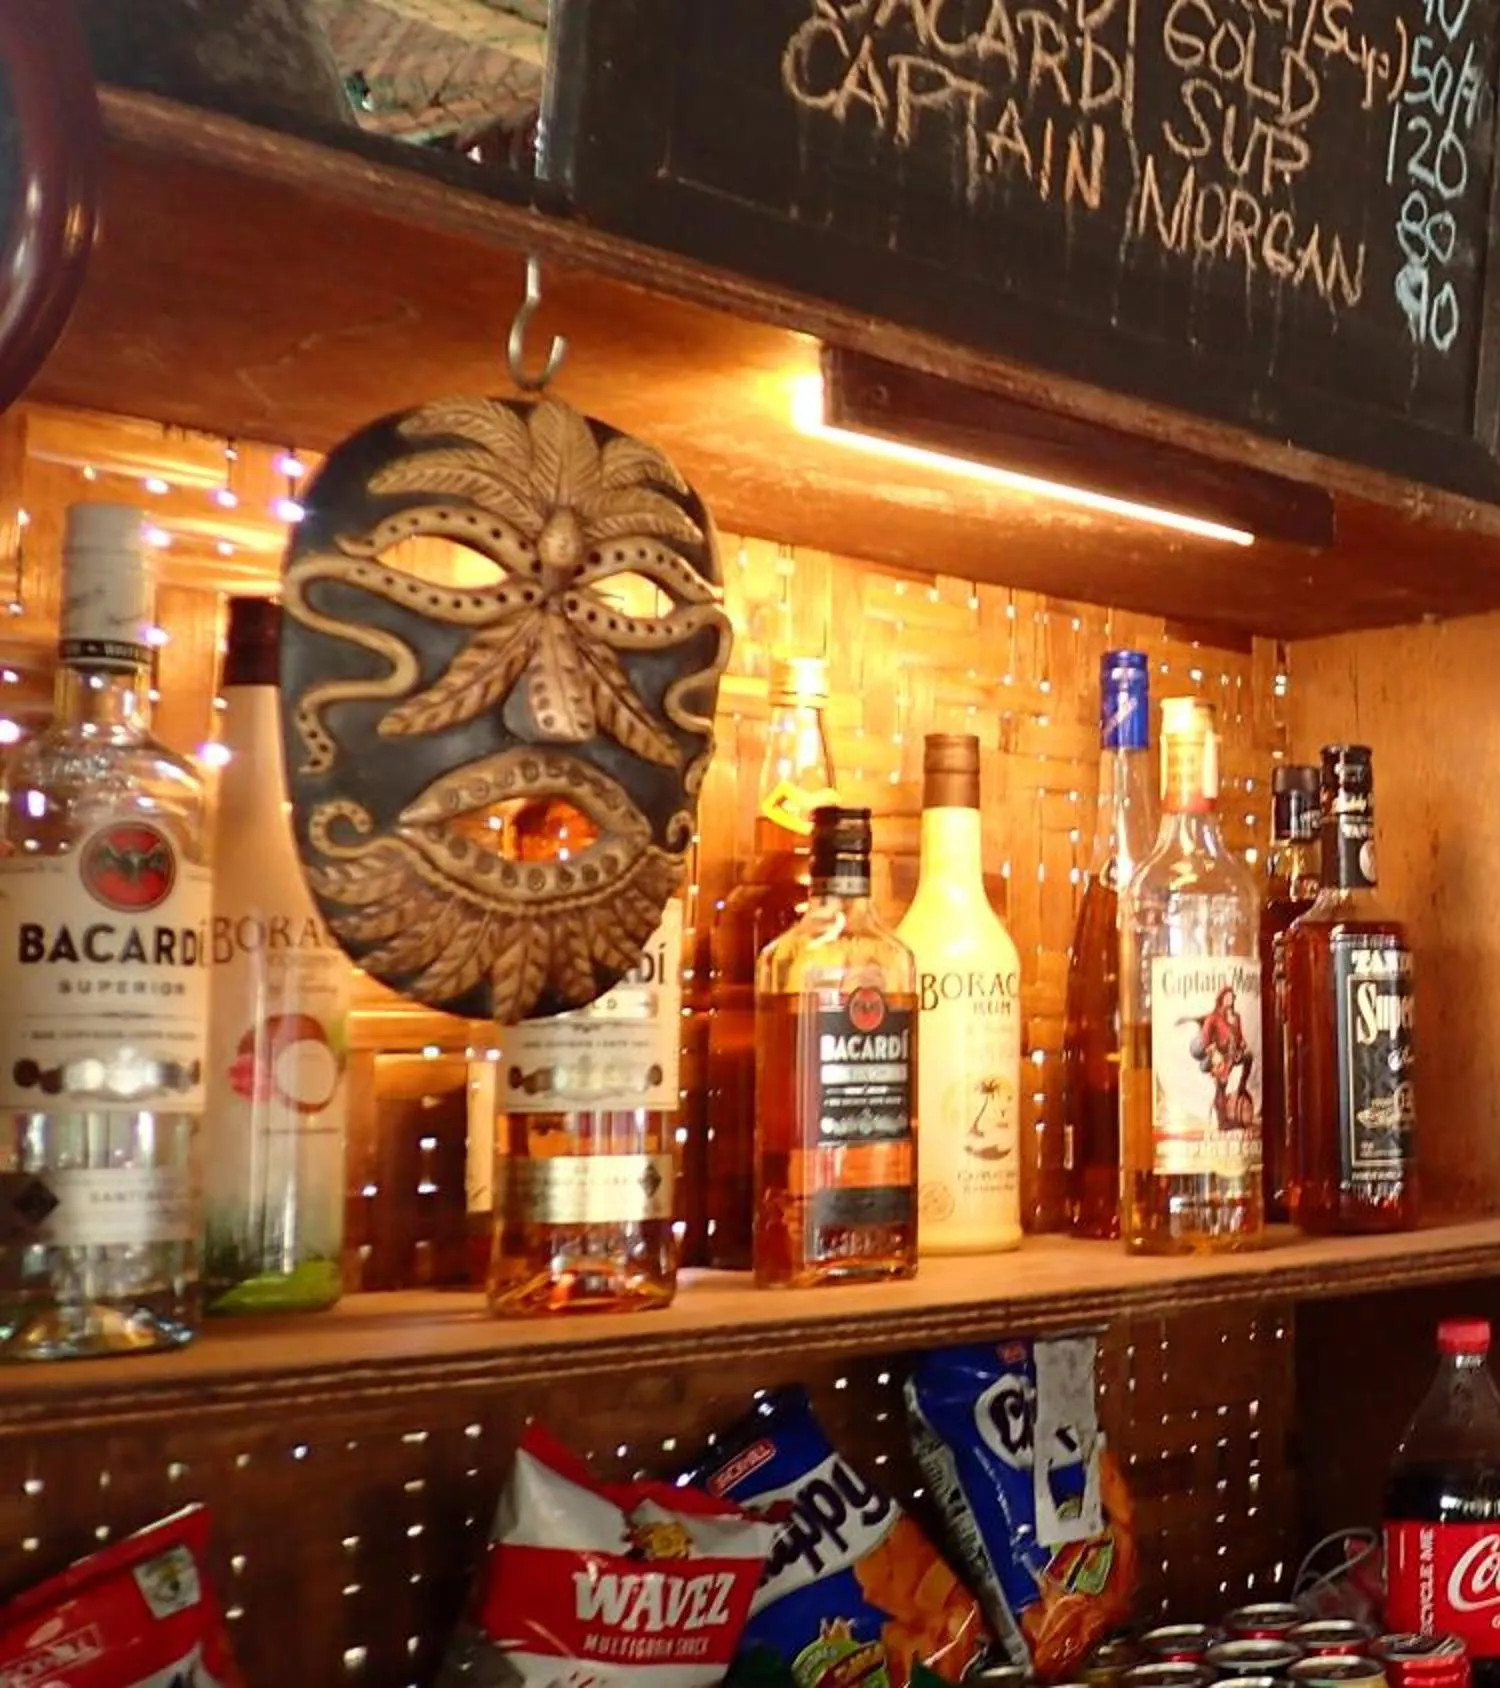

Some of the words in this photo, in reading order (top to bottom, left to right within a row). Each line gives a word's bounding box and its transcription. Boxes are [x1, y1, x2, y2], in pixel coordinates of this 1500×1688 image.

[1163, 0, 1319, 125] GOLD
[1387, 102, 1467, 199] 120
[1164, 79, 1312, 197] SUP
[781, 12, 1106, 211] CAPTAIN
[1138, 155, 1365, 306] MORGAN
[58, 978, 187, 997] SUPERIOR
[1160, 967, 1227, 1000] Captain
[571, 1571, 737, 1632] WAVEZ
